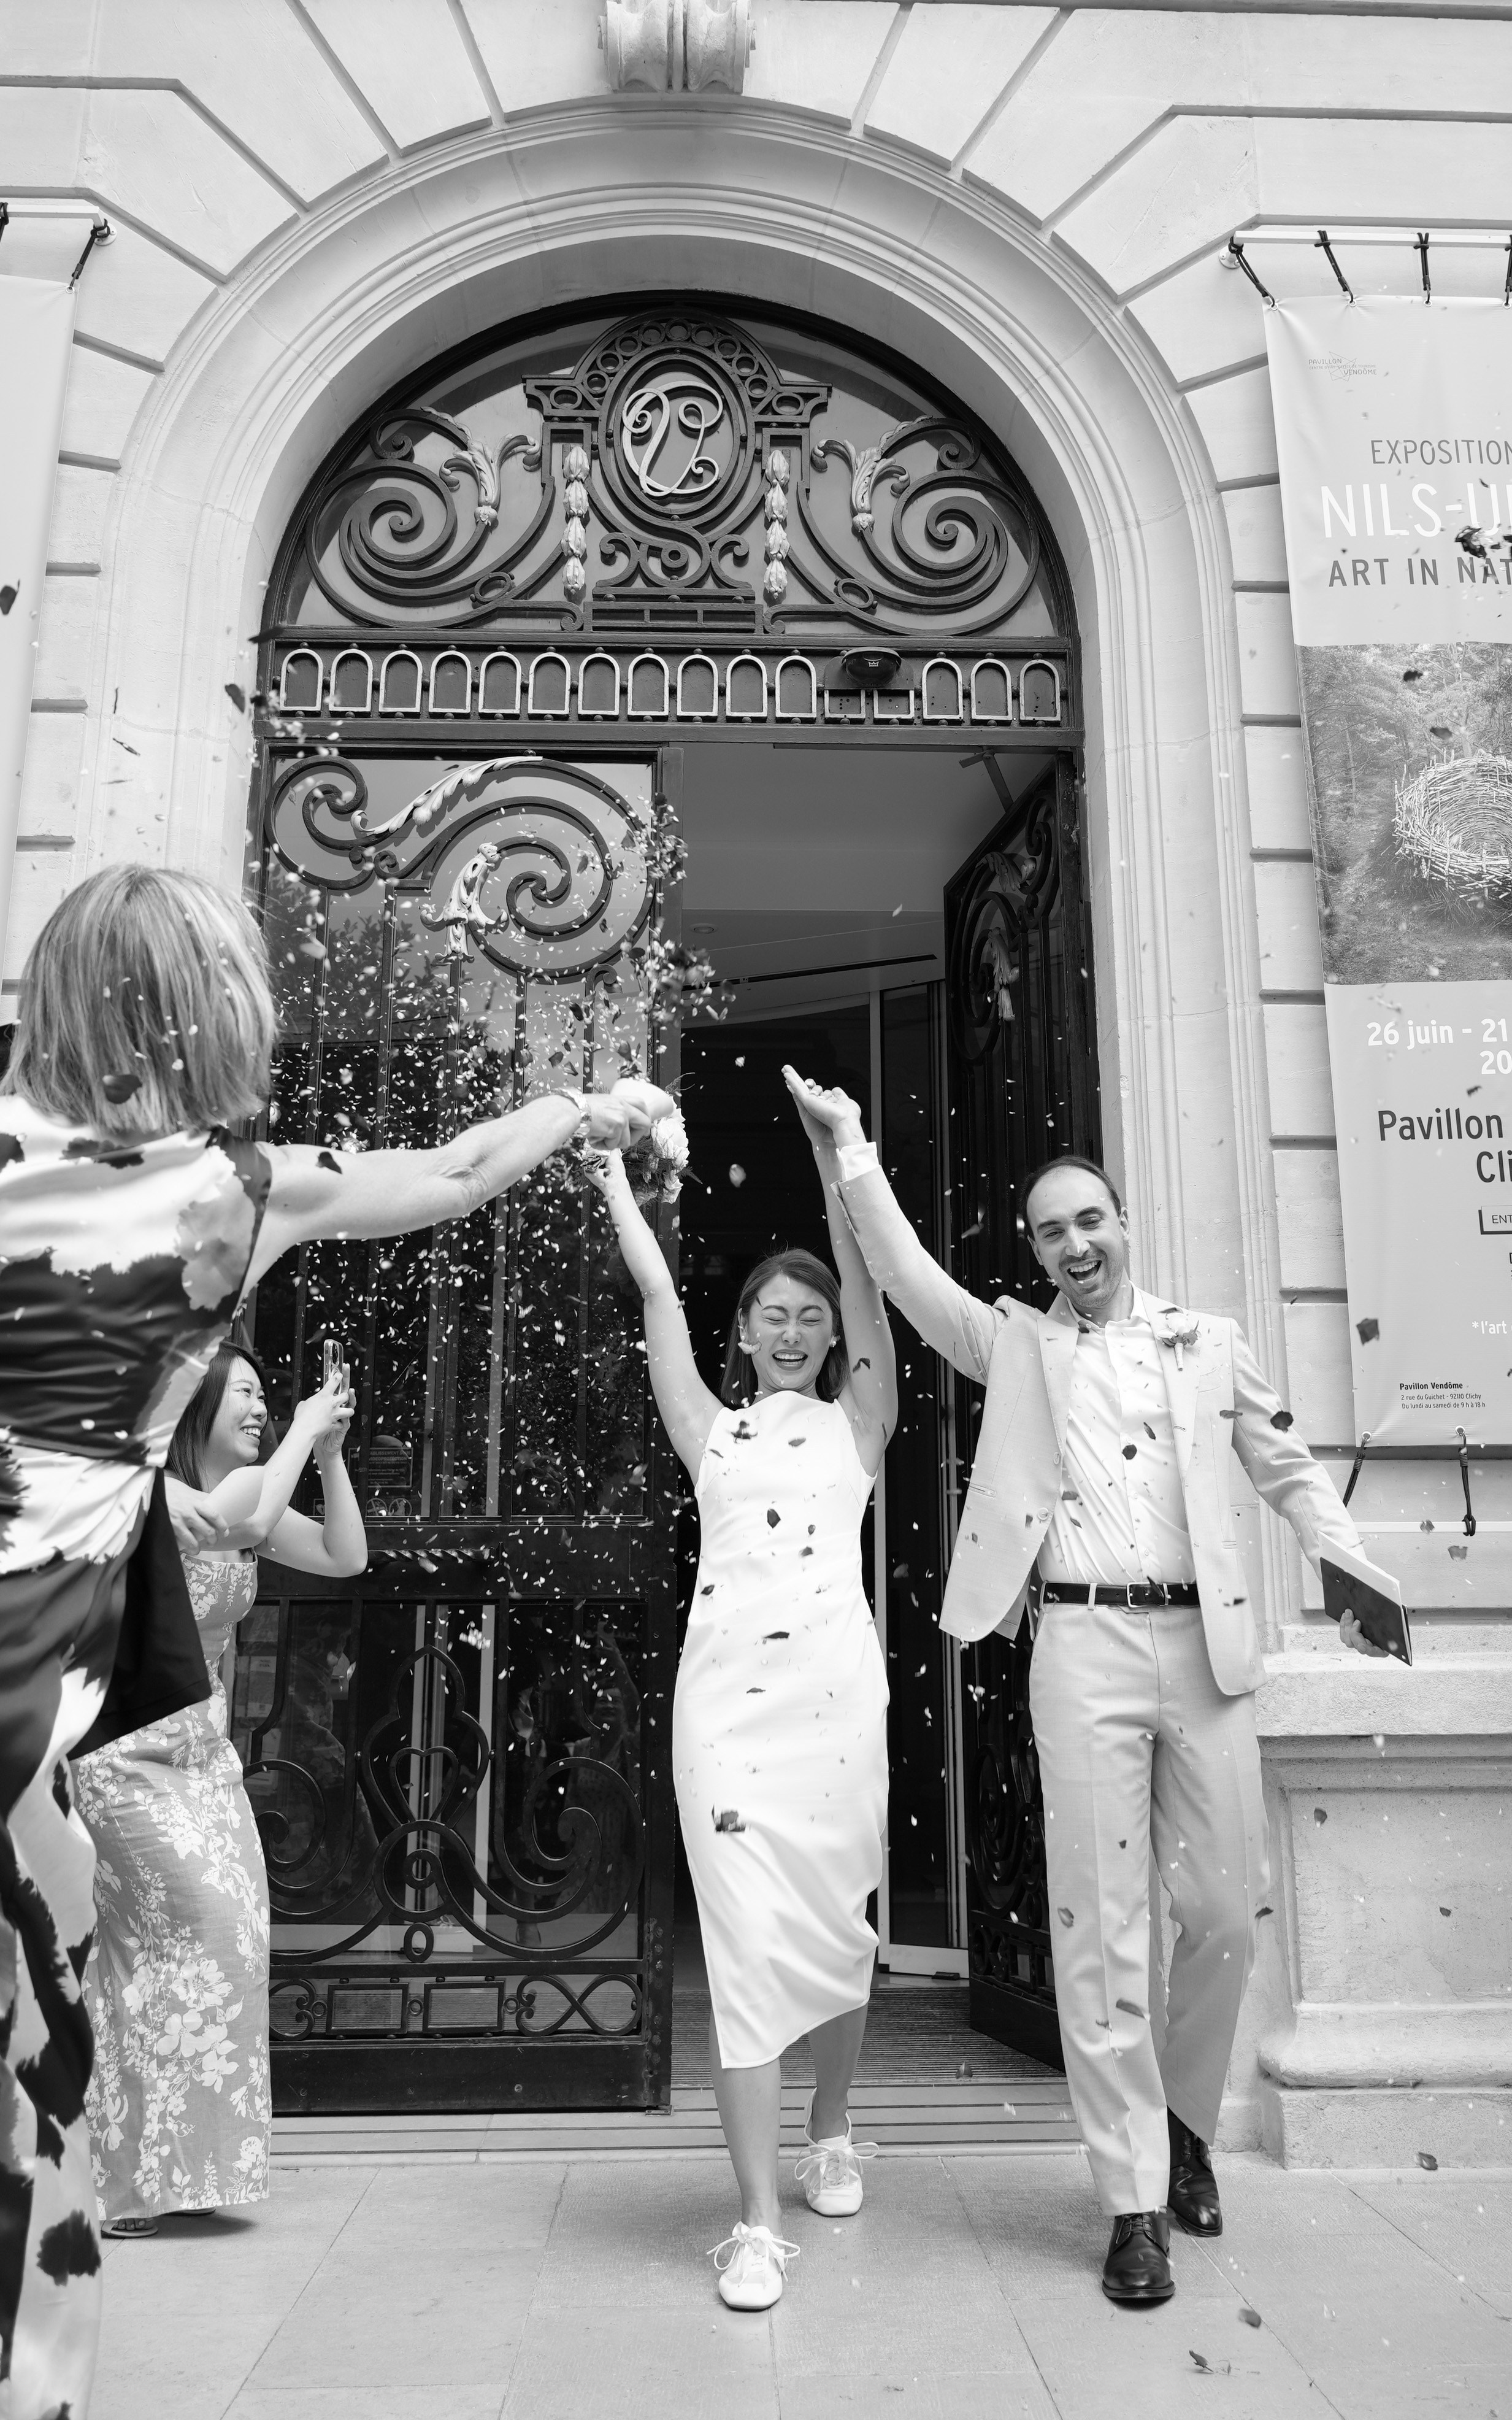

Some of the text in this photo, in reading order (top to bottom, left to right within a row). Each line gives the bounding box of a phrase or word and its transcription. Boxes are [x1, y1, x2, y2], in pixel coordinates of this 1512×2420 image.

[1329, 558, 1389, 587] ART
[1408, 558, 1439, 585] IN
[1367, 1020, 1400, 1046] 26
[1406, 1019, 1454, 1050] juin
[1481, 1018, 1508, 1042] 21
[1479, 1050, 1512, 1074] 20
[1378, 1108, 1503, 1141] Pavillon
